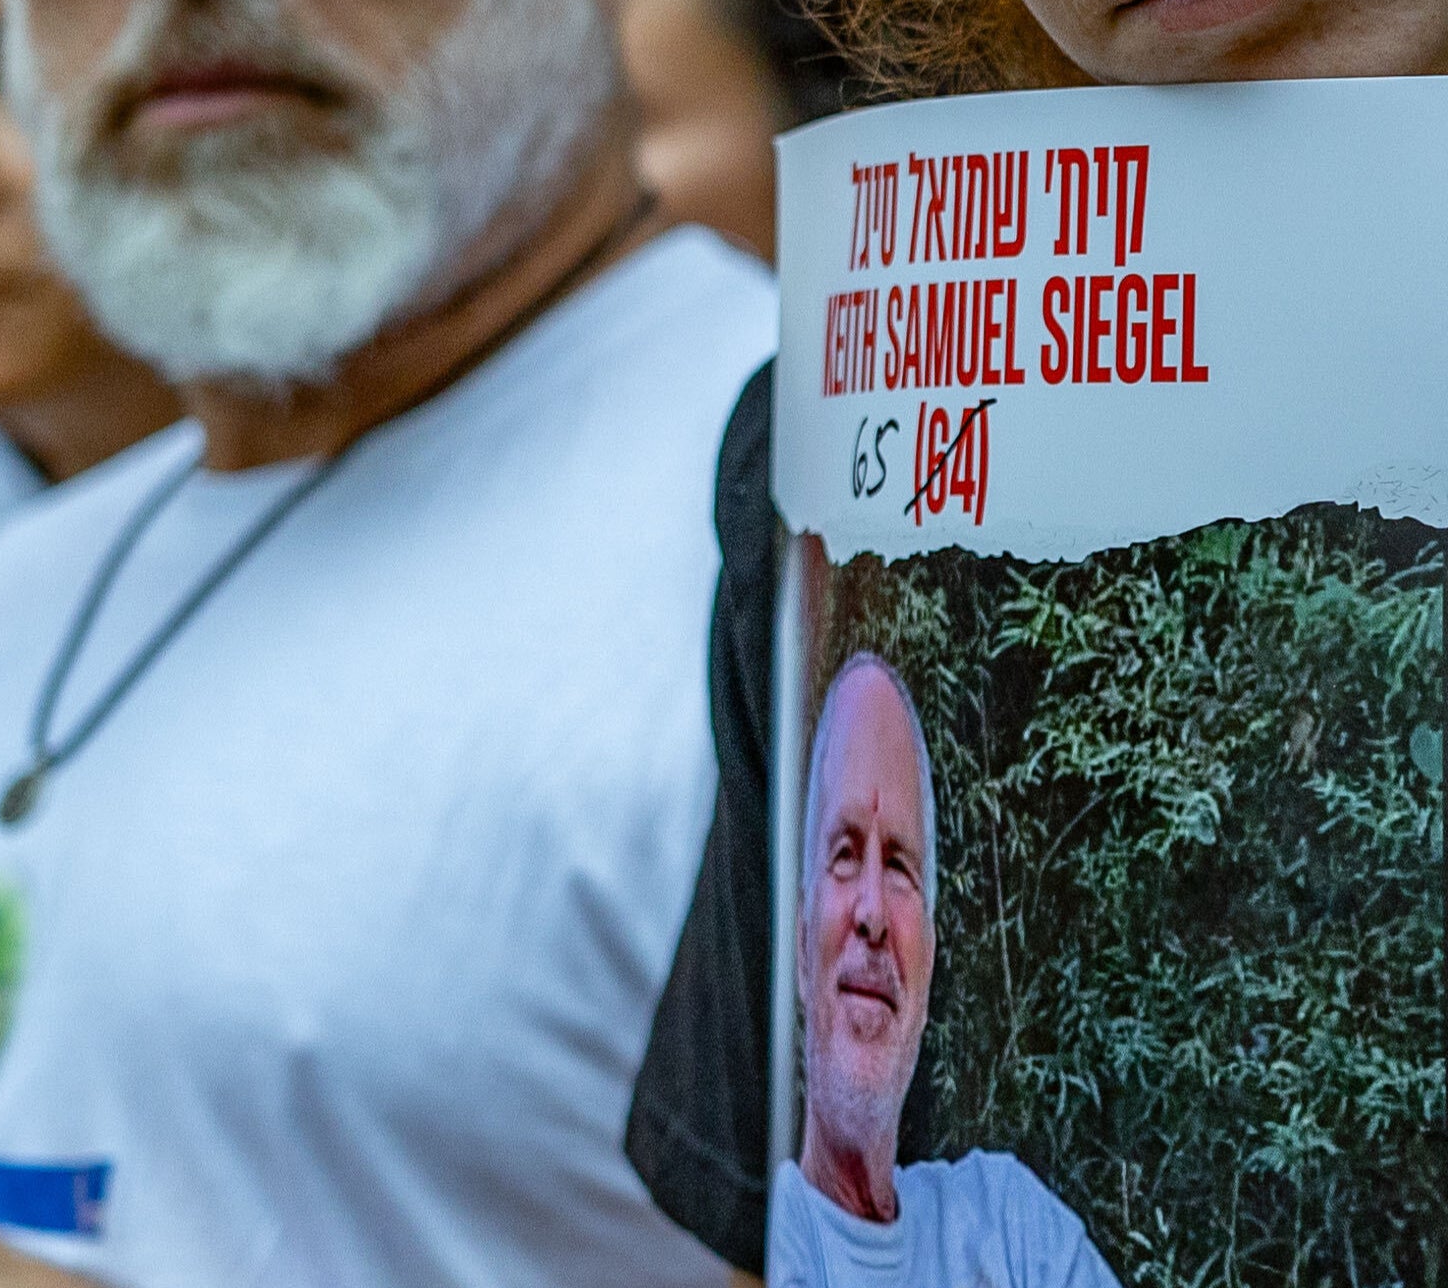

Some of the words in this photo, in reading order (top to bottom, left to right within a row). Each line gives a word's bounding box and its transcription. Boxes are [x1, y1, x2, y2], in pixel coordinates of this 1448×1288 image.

[849, 162, 900, 271] סיגל
[907, 150, 1029, 263] שמואל
[822, 287, 880, 397] KEITH
[884, 278, 1026, 391] SAMUEL
[1040, 273, 1209, 383] SIEGEL
[852, 415, 900, 499] 65
[913, 402, 992, 527] (64)
